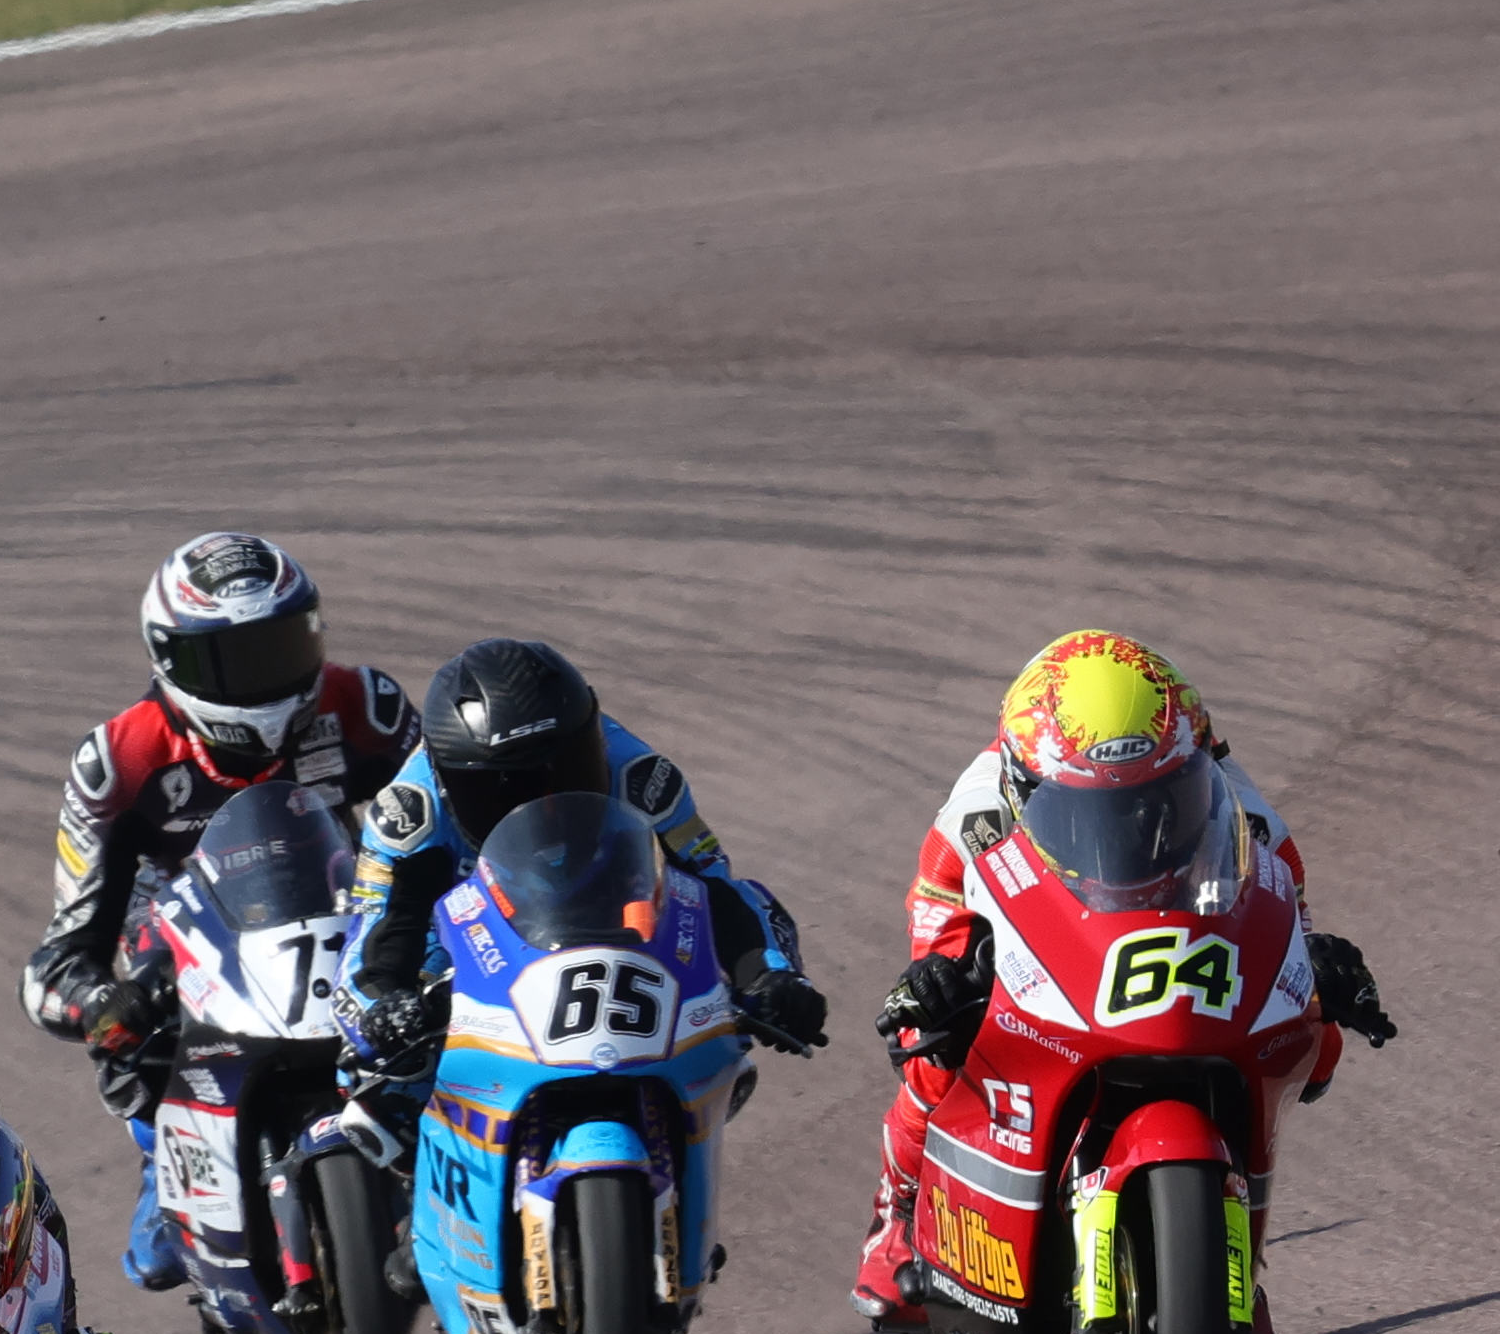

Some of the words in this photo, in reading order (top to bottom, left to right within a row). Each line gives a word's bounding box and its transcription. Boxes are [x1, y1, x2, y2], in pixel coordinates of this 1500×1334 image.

[490, 717, 557, 747] LS2
[1095, 740, 1147, 760] HJC
[546, 962, 663, 1043] 65
[1108, 932, 1240, 1013] 64
[1003, 1012, 1081, 1063] GBRacing
[932, 1184, 962, 1275] City
[959, 1203, 1025, 1299] Lifting
